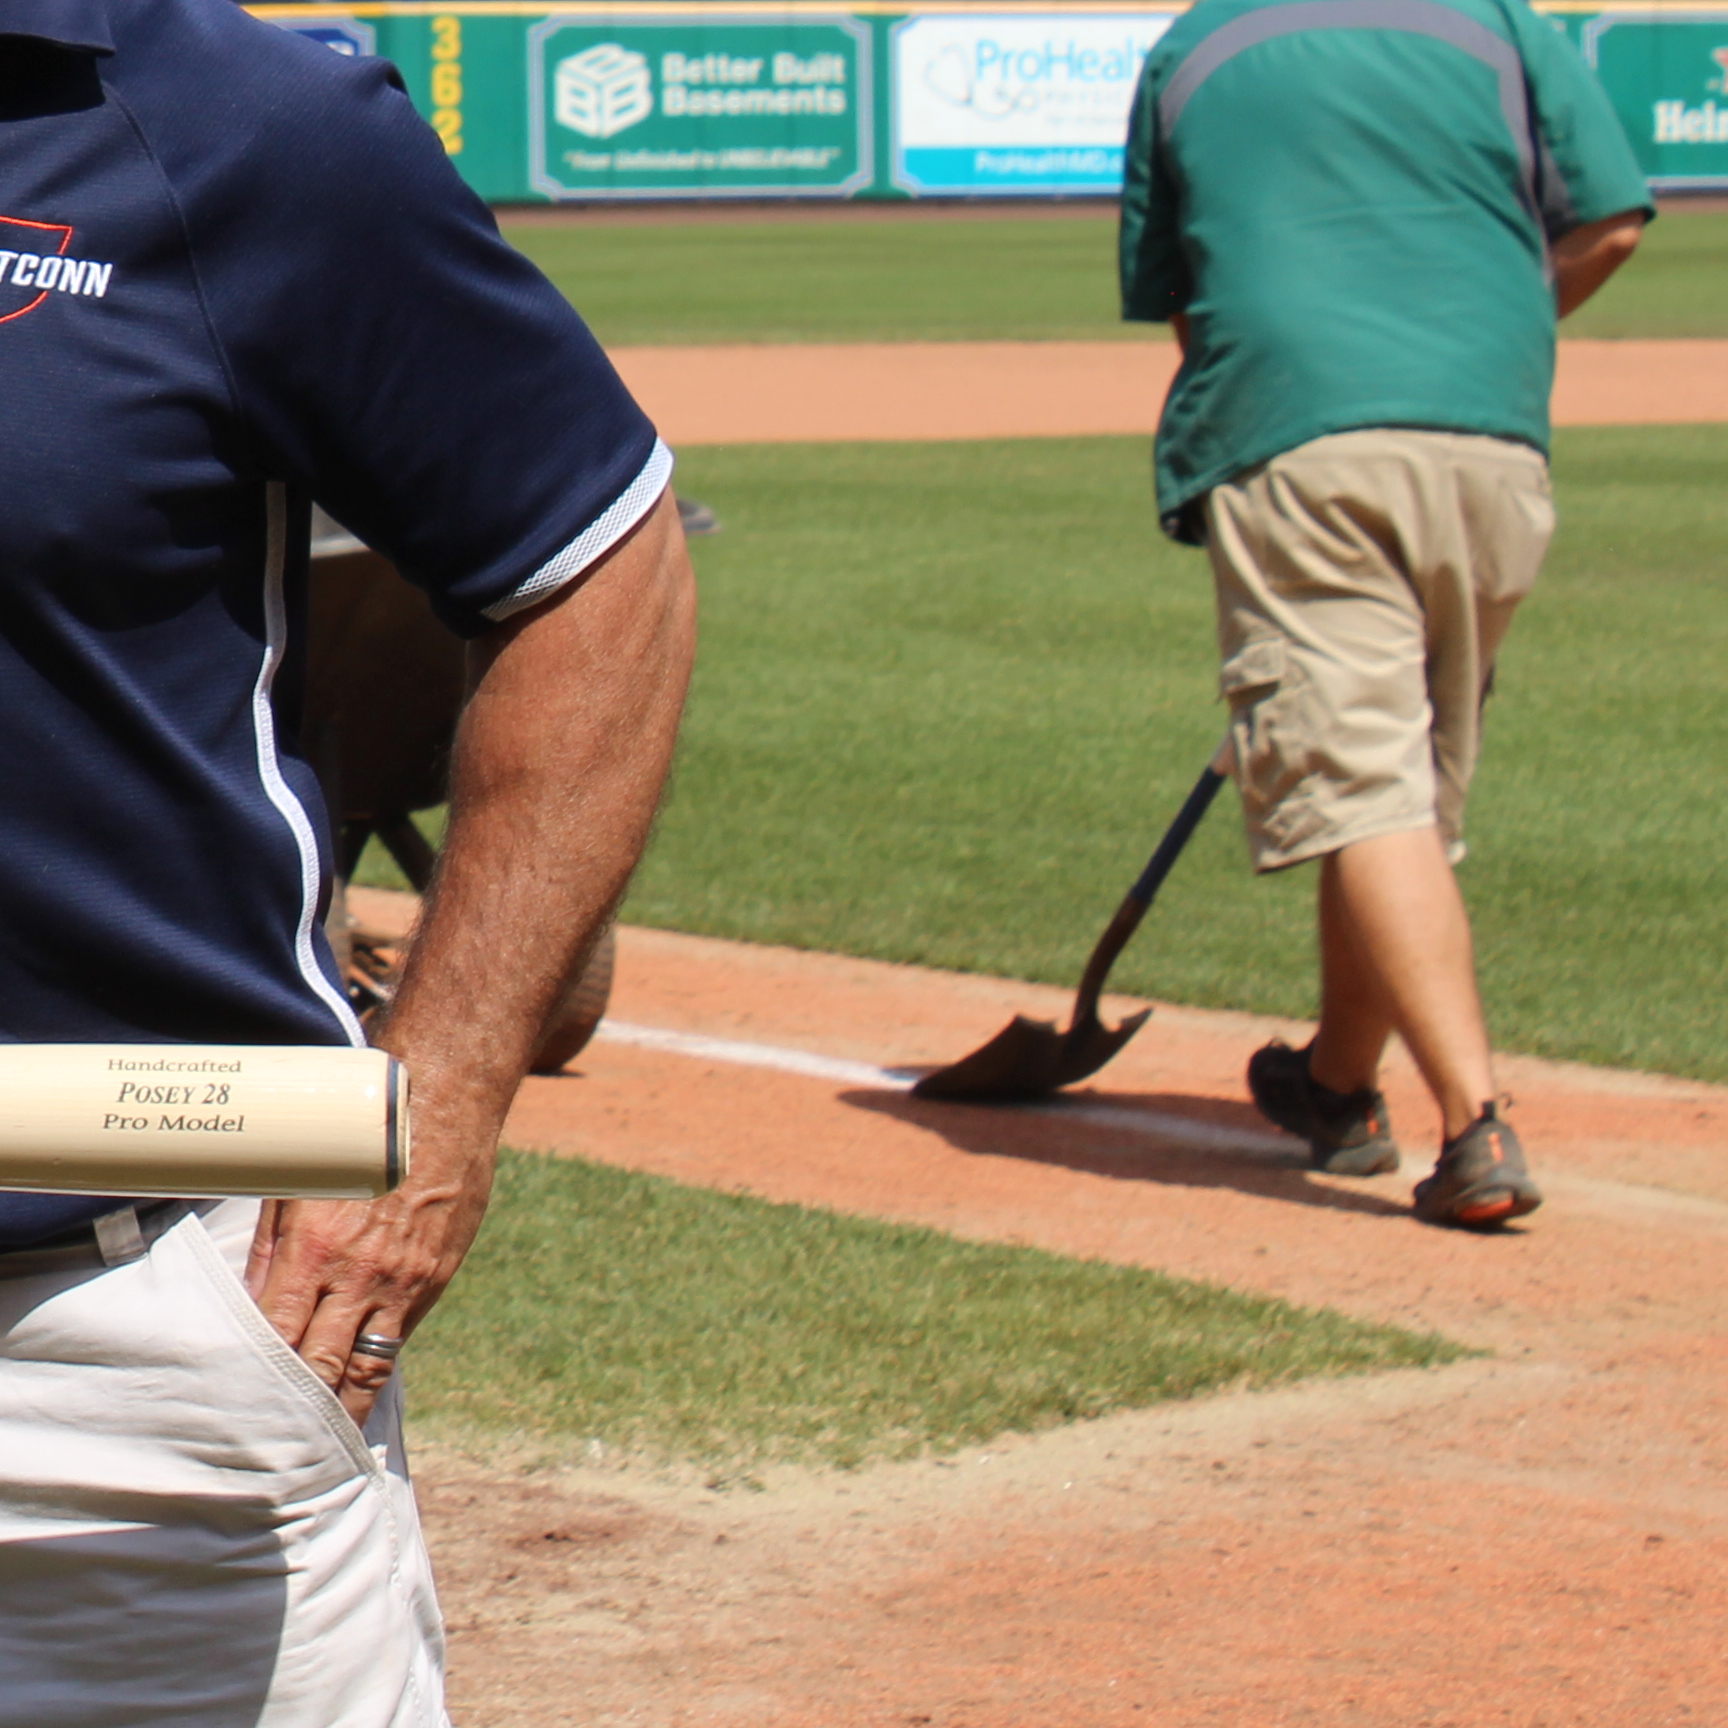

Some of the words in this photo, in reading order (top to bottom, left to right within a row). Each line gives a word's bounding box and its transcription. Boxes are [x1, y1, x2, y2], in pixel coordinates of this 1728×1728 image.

[662, 52, 763, 84] Better
[773, 52, 846, 84] Built
[431, 15, 463, 155] 362
[662, 86, 846, 116] Basements
[107, 1058, 242, 1073] Handcrafted
[201, 1083, 231, 1105] 28
[102, 1113, 149, 1130] Pro
[158, 1115, 245, 1132] Model
